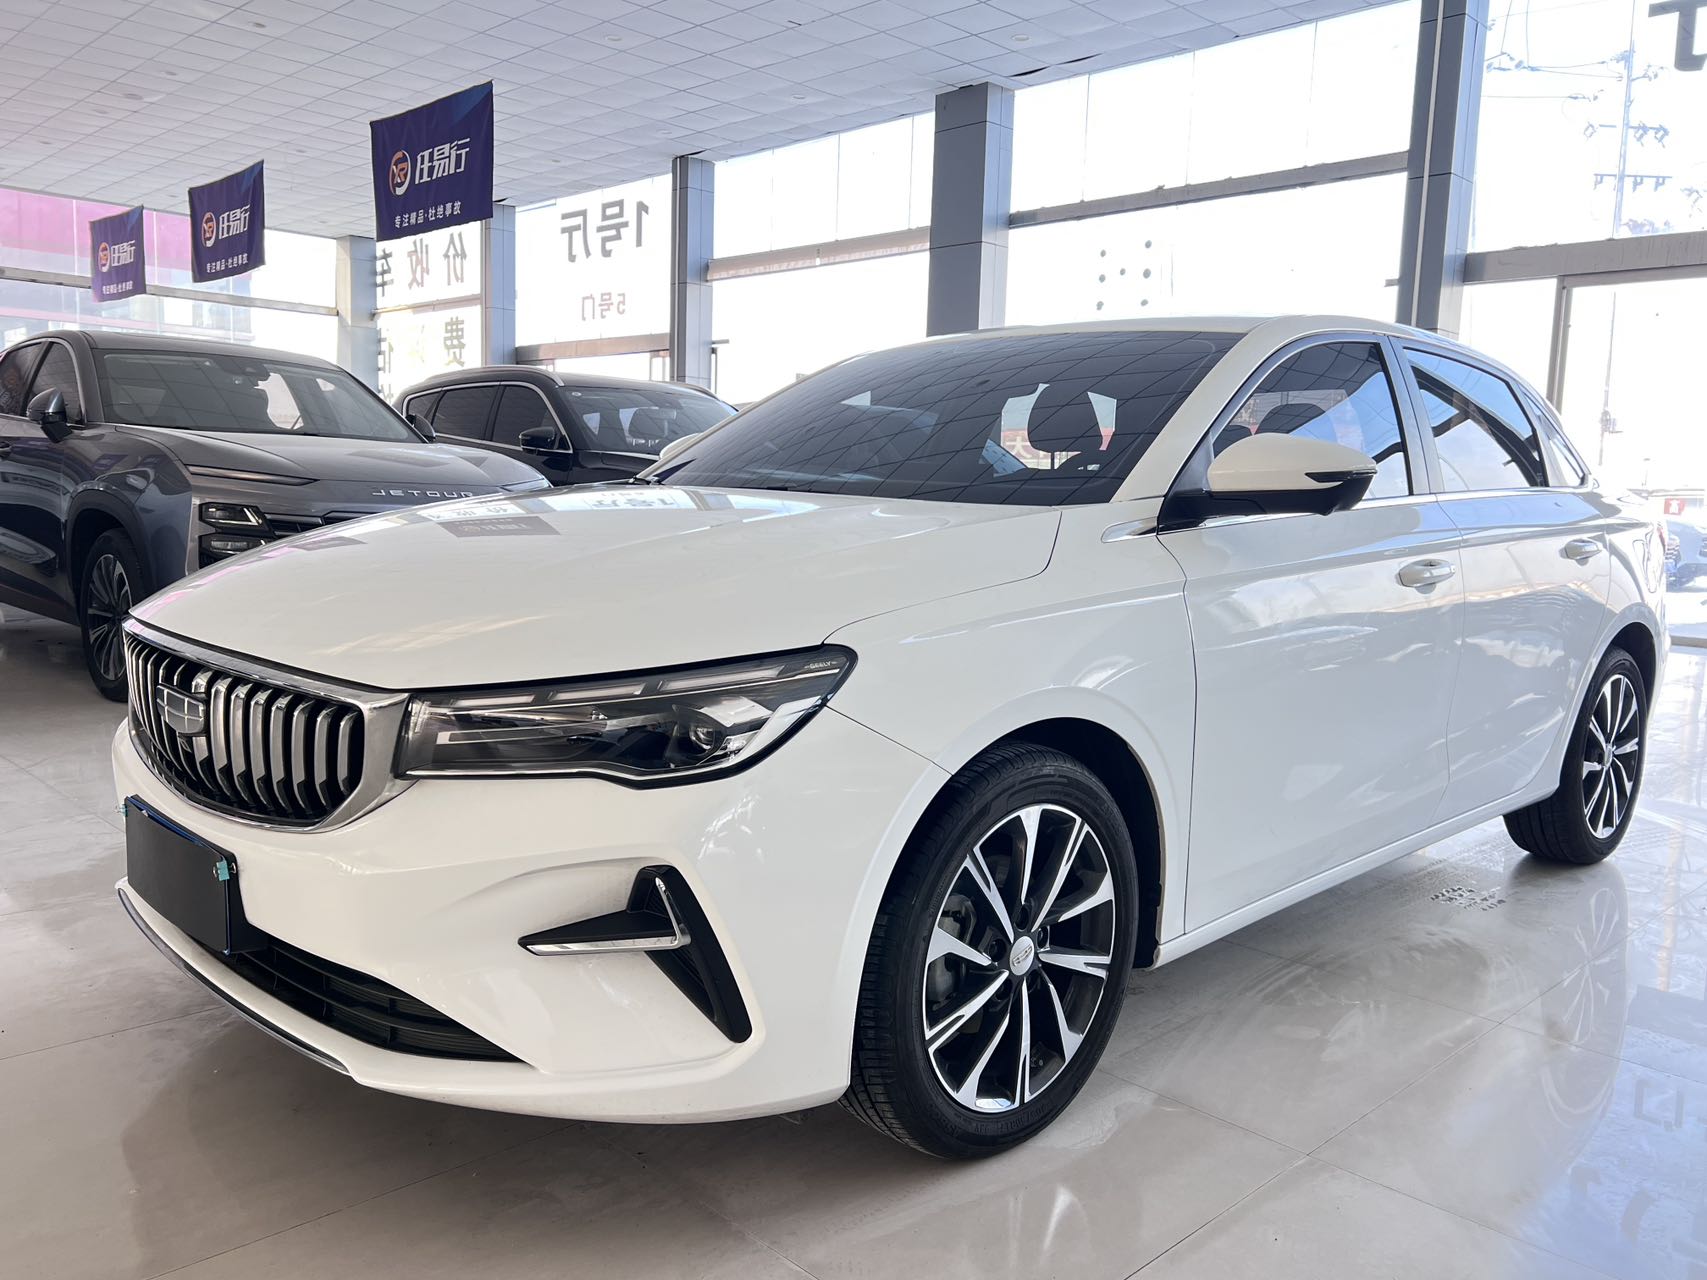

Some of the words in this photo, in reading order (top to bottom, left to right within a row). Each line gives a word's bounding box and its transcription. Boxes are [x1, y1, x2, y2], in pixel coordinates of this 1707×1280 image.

[415, 138, 470, 184] 任易行
[219, 204, 250, 239] 任易行
[372, 488, 473, 498] JETOUR
